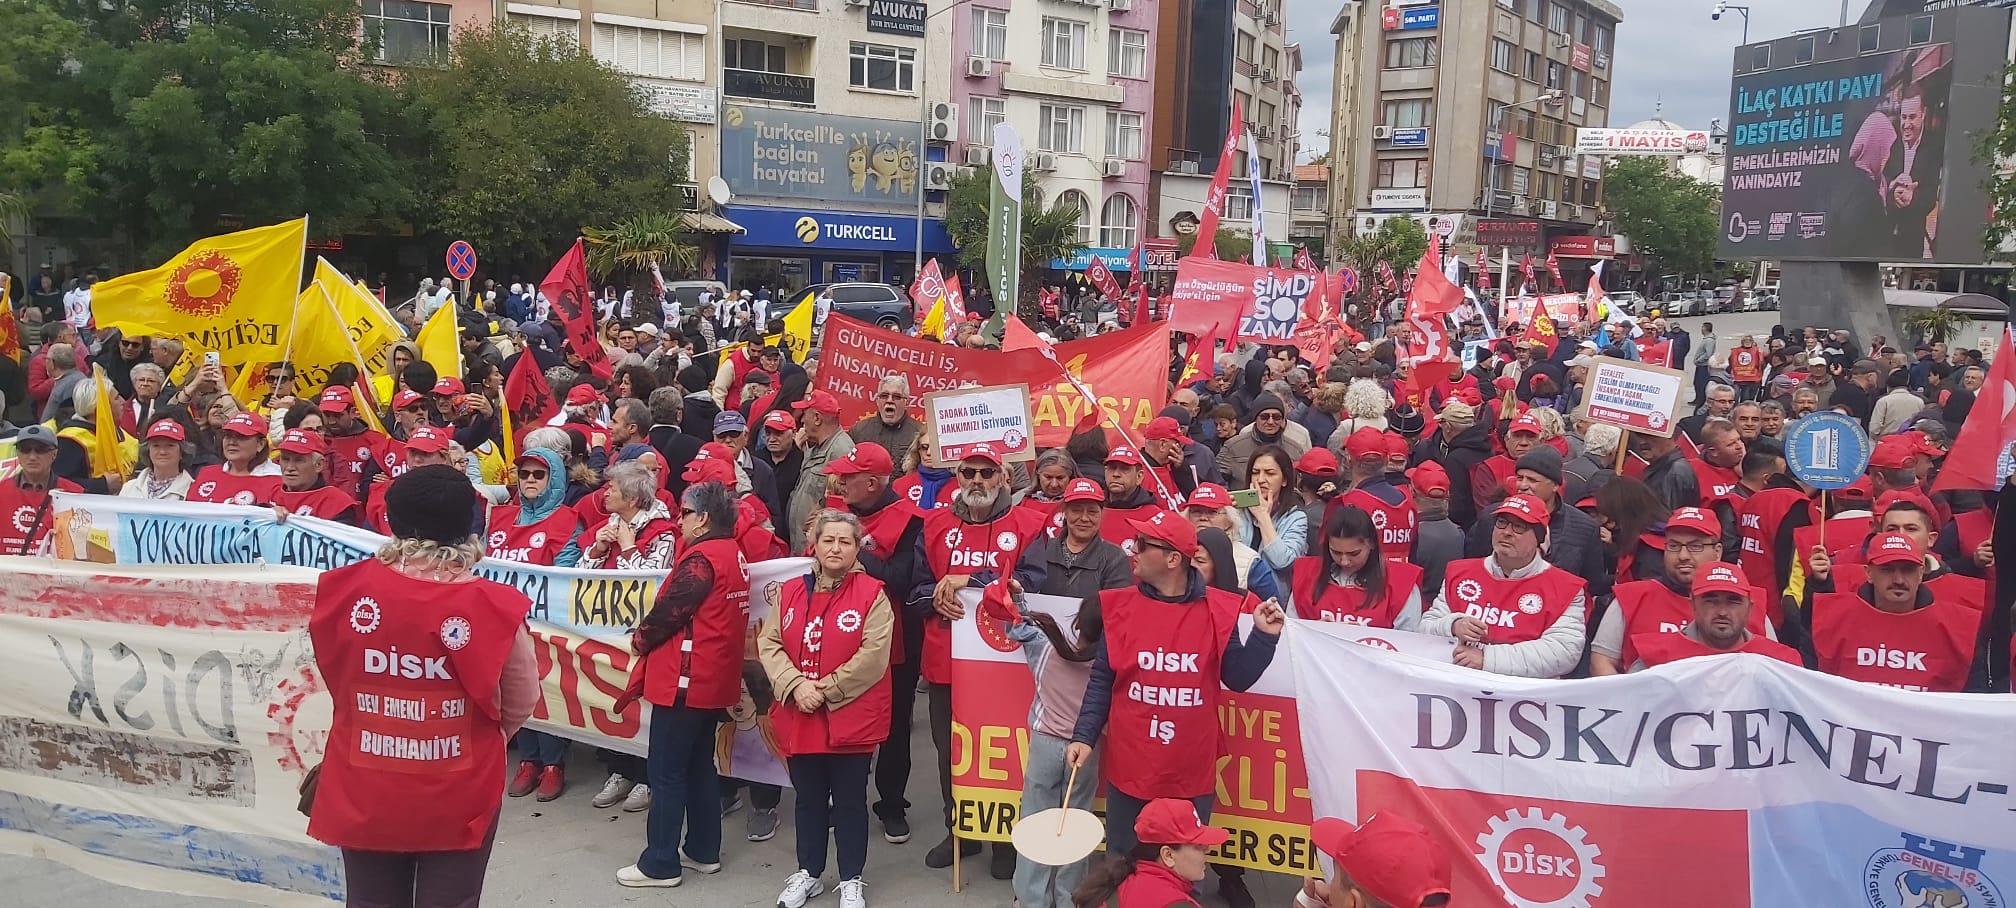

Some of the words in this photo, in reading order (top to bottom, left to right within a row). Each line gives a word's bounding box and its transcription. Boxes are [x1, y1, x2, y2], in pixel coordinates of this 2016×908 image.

[872, 1, 925, 20] AVUKAT
[754, 74, 811, 90] AVUKAT
[1737, 86, 1776, 118] İLAÇ
[1780, 79, 1834, 109] KATKI
[1838, 73, 1883, 101] PAYI
[753, 121, 845, 145] Turkcell'le
[1735, 110, 1809, 146] DESTEĞİ
[1813, 109, 1844, 138] İLE
[753, 141, 818, 165] bağlan
[1605, 136, 1614, 147] 1
[1620, 136, 1683, 147] MAYIS
[1732, 144, 1840, 171] EMEKLİLERİMİZİN
[753, 162, 825, 186] hayata!
[1731, 171, 1801, 190] YANINDAYIZ
[825, 224, 896, 241] TURKCELL
[1100, 254, 1133, 268] piyang
[1146, 251, 1179, 265] OTEL
[1191, 279, 1245, 294] Özgürlüğün
[1252, 271, 1317, 299] ŞİMDİ
[1238, 316, 1299, 339] ZAMA
[838, 328, 935, 367] GÜVENCELİ
[938, 353, 959, 373] İŞ,
[1598, 377, 1619, 387] TESLİM
[1600, 368, 1624, 380] SEFALETE
[827, 376, 865, 399] HAK
[1594, 392, 1625, 405] EMEKLİNİN
[1596, 384, 1621, 396] İNSANCA
[939, 407, 968, 420] SADAKA
[969, 402, 993, 416] DEĞİL,
[1033, 396, 1153, 431] AYIS'A
[941, 421, 980, 434] HAKKIMIZI
[1383, 525, 1411, 543] DİSK
[1886, 535, 1905, 544] DİSK
[493, 547, 532, 561] DİSK
[951, 547, 999, 568] DİSK
[1712, 567, 1733, 575] DİSK
[356, 608, 374, 621] DİSK
[1465, 603, 1520, 628] DİSK
[364, 645, 453, 679] DİSK
[1138, 647, 1199, 673] DİSK
[1857, 644, 1927, 671] DİSK
[1128, 682, 1204, 707] GENEL
[357, 692, 379, 713] DEV
[384, 696, 426, 721] EMEKLİ
[441, 698, 465, 719] SEN
[1149, 714, 1176, 744] İŞ
[360, 730, 461, 760] BURHANİYE
[1410, 690, 2010, 812] DİSK/GENEL-
[1503, 844, 1575, 878] DİSK
[1869, 853, 1901, 880] TÜRKİYE
[1899, 851, 1977, 888] GENEL-İŞ
